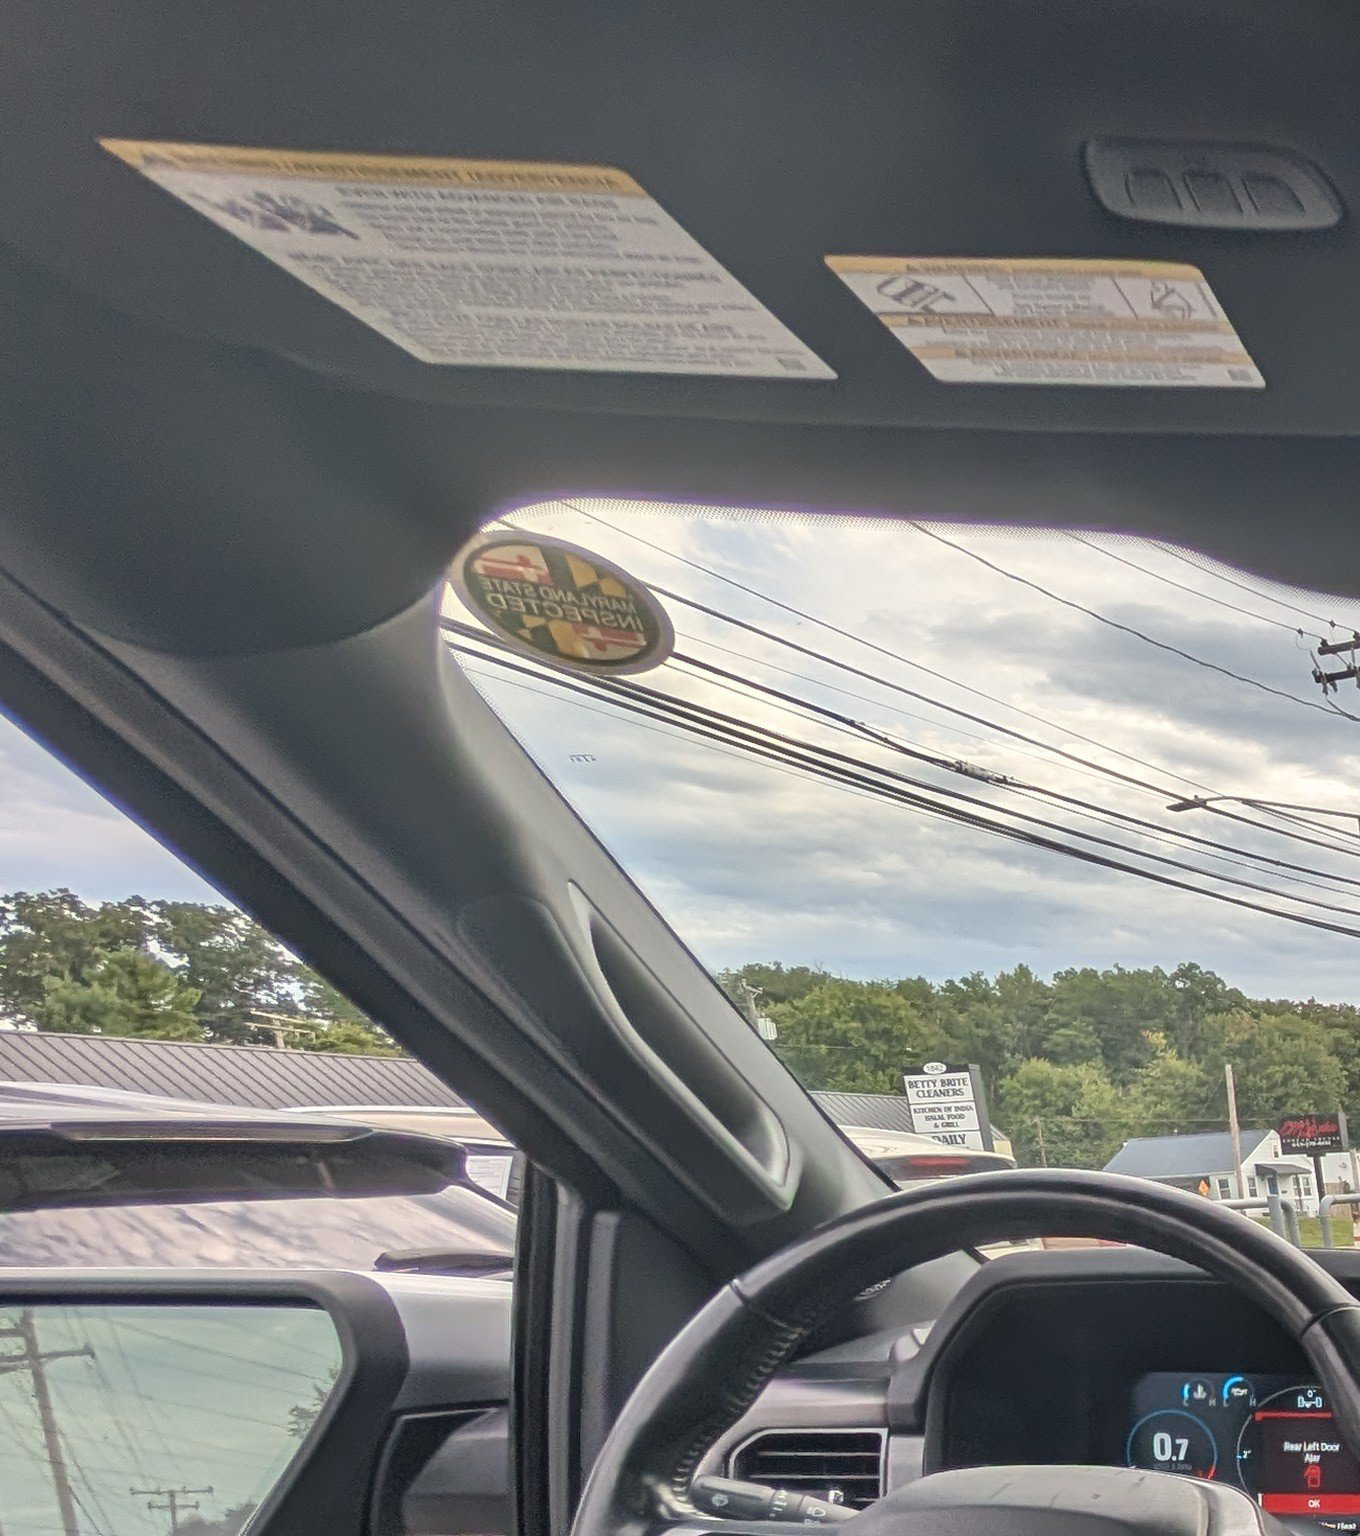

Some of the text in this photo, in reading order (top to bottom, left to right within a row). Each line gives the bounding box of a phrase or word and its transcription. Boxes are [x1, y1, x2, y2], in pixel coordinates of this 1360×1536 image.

[908, 1077, 969, 1089] BETTY BRITE
[916, 1088, 965, 1098] CLEANERS
[913, 1106, 943, 1114] KITCHEN
[1153, 1432, 1189, 1461] 0.7
[1283, 1441, 1340, 1451] Rear Left Door
[1308, 1499, 1321, 1508] OK
